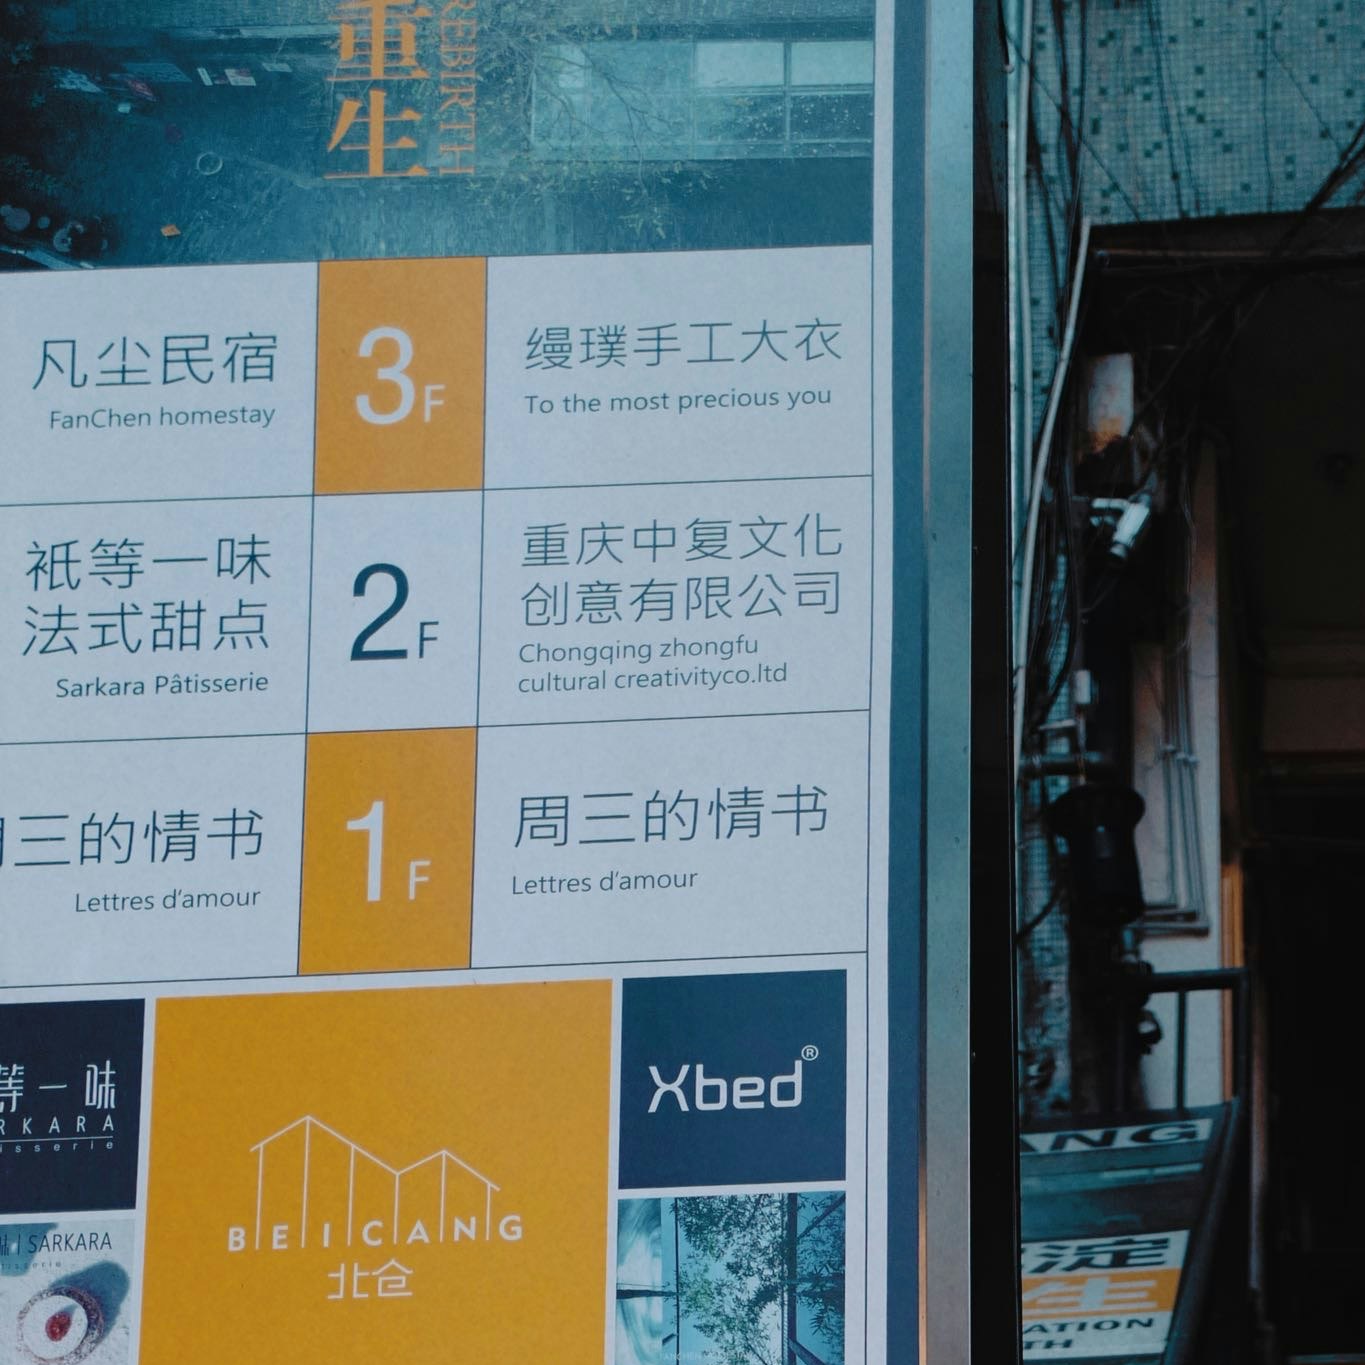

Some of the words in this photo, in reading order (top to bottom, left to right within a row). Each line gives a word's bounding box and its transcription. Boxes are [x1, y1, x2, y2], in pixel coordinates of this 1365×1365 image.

[324, 0, 434, 180] 重生
[32, 331, 277, 390] 凡尘民宿
[524, 318, 843, 371] 缦璞手工大衣
[50, 408, 151, 430] FanChen
[160, 405, 276, 429] homestay
[525, 395, 554, 414] To
[562, 393, 601, 413] the
[610, 391, 669, 412] most
[678, 388, 780, 414] precious
[787, 389, 832, 411] you
[521, 512, 843, 568] 重庆中复文化
[520, 571, 840, 627] 创意有限公司
[22, 598, 270, 656] 法式甜点
[518, 640, 652, 666] Chongqing
[659, 634, 759, 660] zhongfu
[56, 677, 145, 698] Sarkara
[155, 671, 270, 695] Pâtisserie
[518, 670, 606, 693] cultural
[513, 783, 829, 849] 周三的情书
[0, 808, 264, 867] 三的情书
[75, 891, 155, 913] Lettres
[162, 887, 262, 910] d'amour
[512, 872, 592, 896] Lettres
[599, 870, 699, 893] d'amour
[1021, 1124, 1198, 1152] NG
[28, 1232, 113, 1254] SARKARA
[227, 1214, 524, 1252] BEICANG
[1023, 1237, 1170, 1274] 淀
[327, 1257, 414, 1300] 北仓
